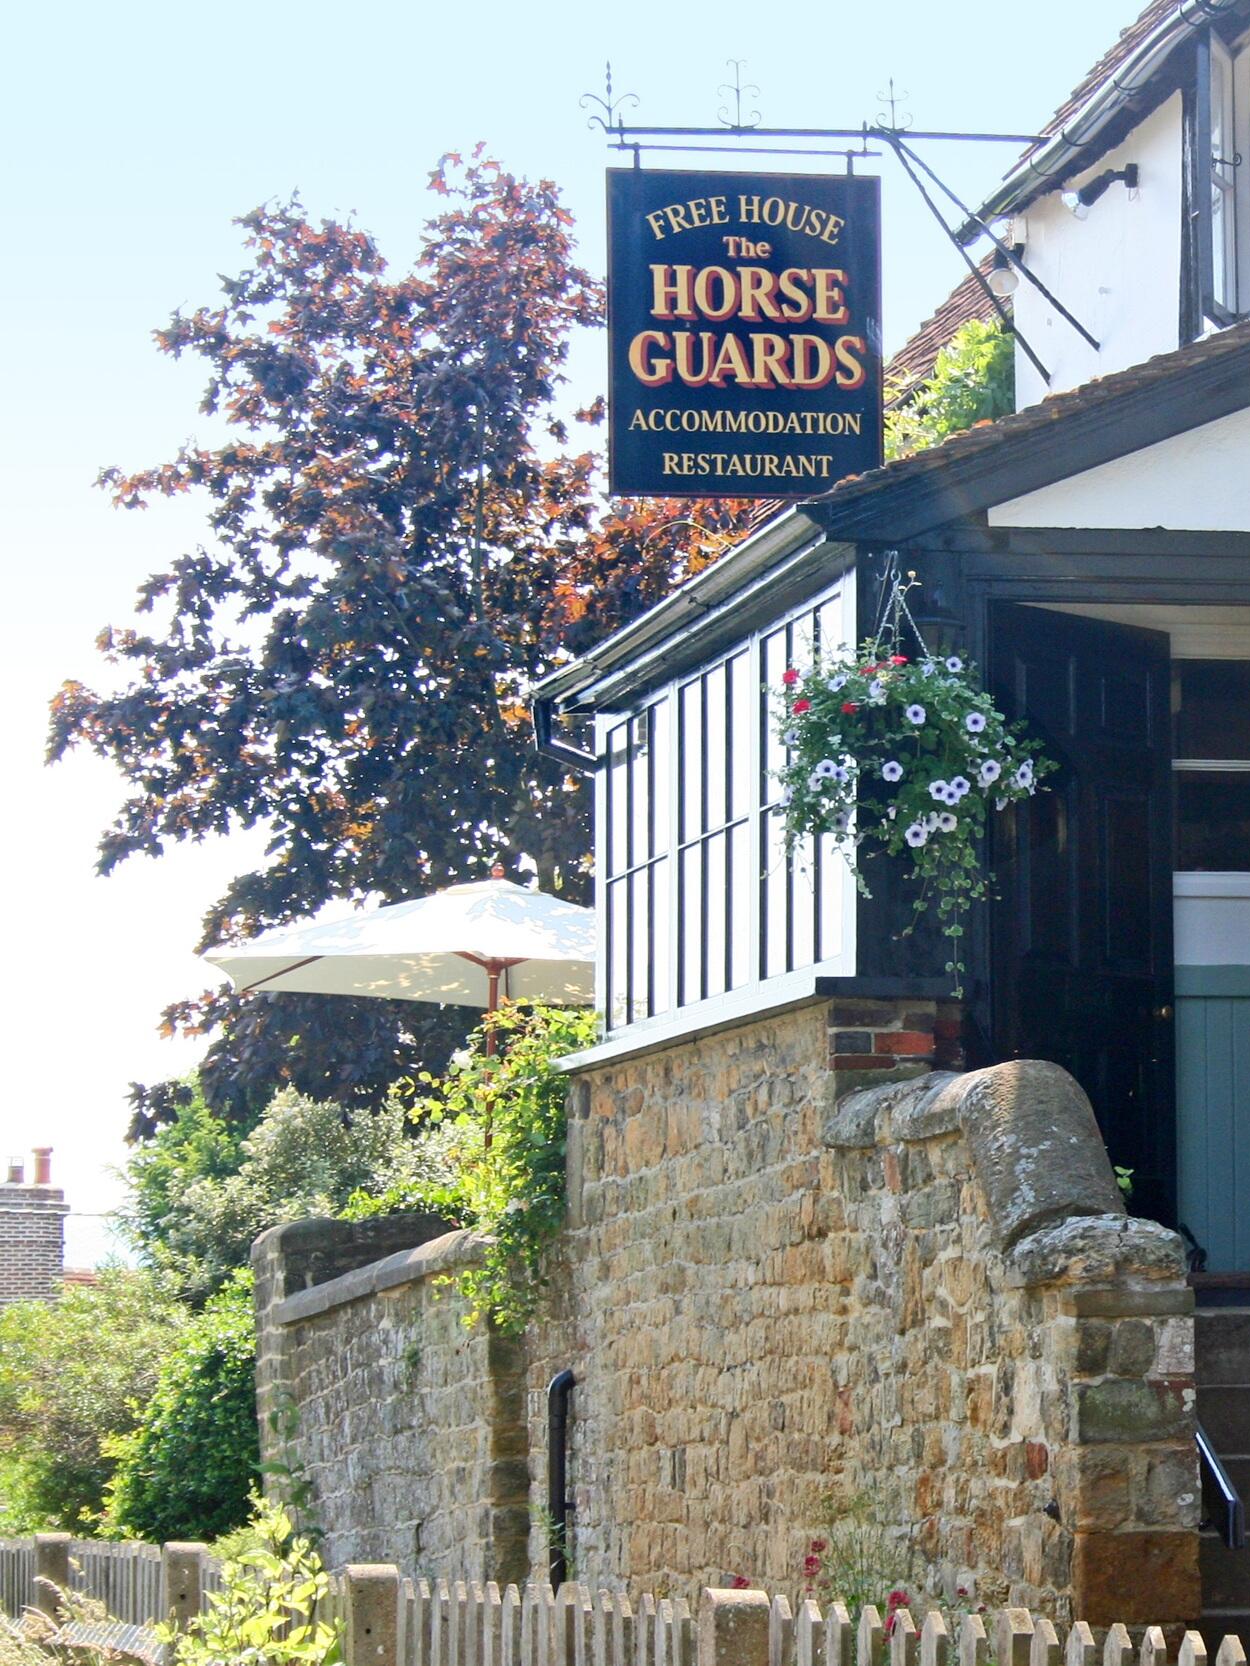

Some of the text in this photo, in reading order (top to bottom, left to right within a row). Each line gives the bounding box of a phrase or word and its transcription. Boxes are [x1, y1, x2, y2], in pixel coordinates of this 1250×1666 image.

[646, 195, 845, 245] FREE HOUSE
[722, 236, 772, 258] The
[649, 264, 849, 324] HORSE
[628, 330, 866, 389] GUARDS
[628, 409, 862, 435] ACCOMMODATION
[662, 453, 833, 477] RESTAURANT
